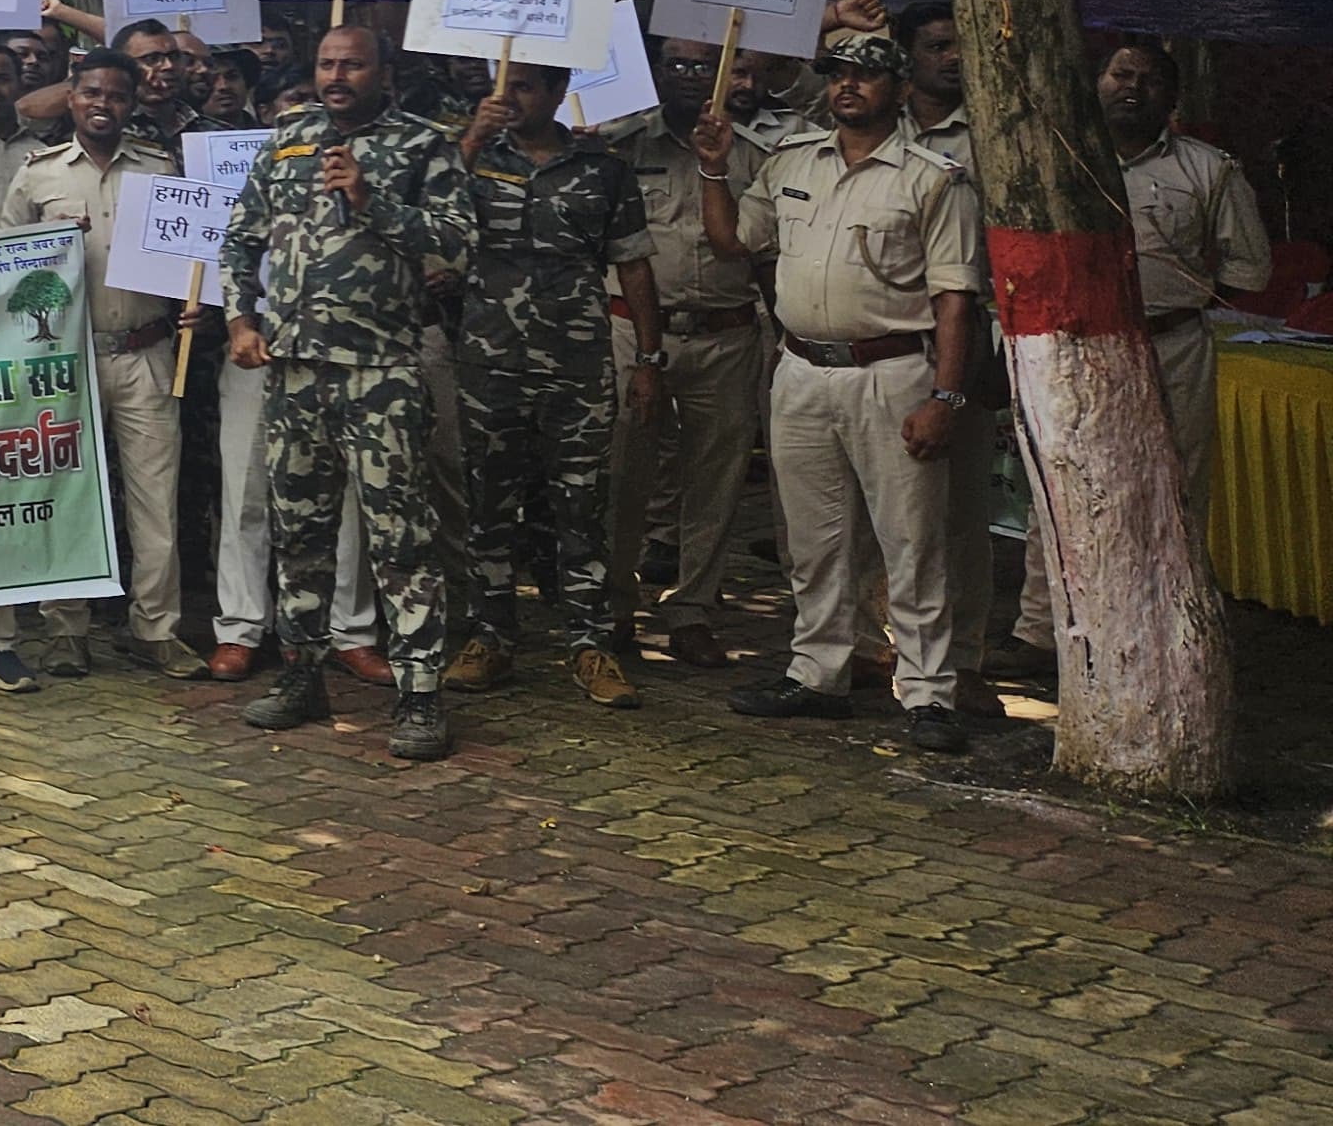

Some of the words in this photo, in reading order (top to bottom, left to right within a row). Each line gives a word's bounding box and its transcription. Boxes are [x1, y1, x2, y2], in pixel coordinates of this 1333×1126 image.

[156, 185, 211, 208] हमारी
[156, 217, 189, 241] पूरी
[5, 243, 28, 254] राज्य
[32, 239, 55, 250] अवर
[57, 236, 74, 246] वन
[25, 342, 78, 399] संघ
[21, 498, 55, 525] तक
